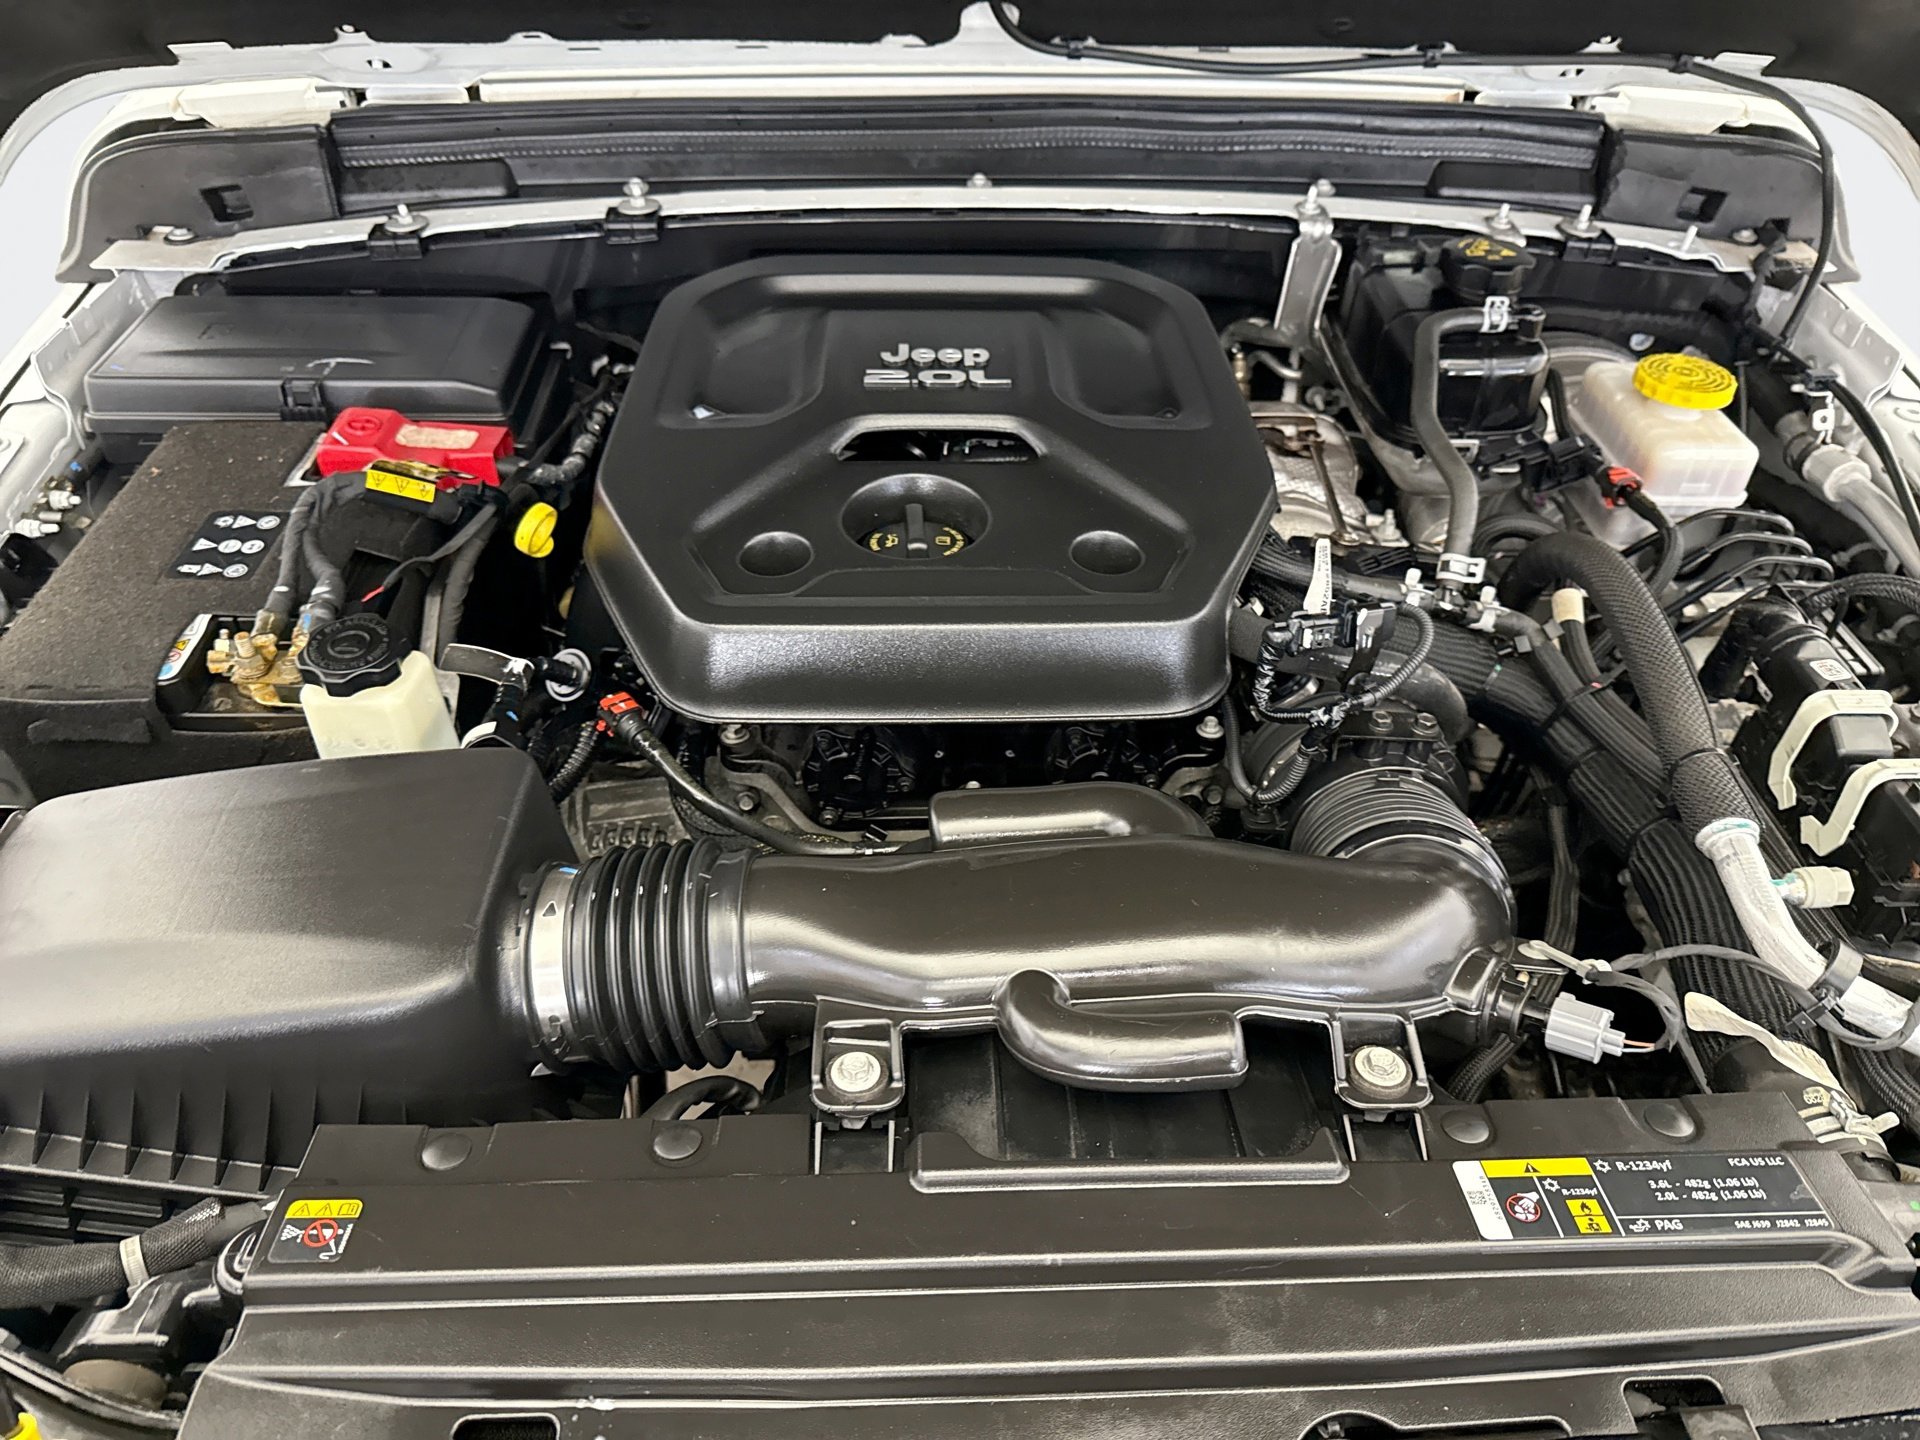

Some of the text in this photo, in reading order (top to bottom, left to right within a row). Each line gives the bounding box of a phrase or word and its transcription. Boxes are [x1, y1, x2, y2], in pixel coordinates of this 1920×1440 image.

[880, 343, 990, 367] Jeep
[863, 369, 1012, 387] 2.0L
[1615, 1160, 1672, 1172] R-1234yf
[1727, 1157, 1785, 1167] FCA US LLC
[1648, 1179, 1673, 1189] 3.6L
[1684, 1178, 1711, 1189] 482g
[1712, 1177, 1741, 1189] (1.06
[1740, 1176, 1760, 1188] Lb)
[1561, 1188, 1598, 1196] R-1234yf
[1655, 1191, 1680, 1201] 2.0L
[1691, 1190, 1719, 1201] 482g
[1720, 1189, 1749, 1201] (1.06
[1747, 1188, 1767, 1200] Lb)
[1655, 1219, 1684, 1231] PAG
[1734, 1220, 1752, 1229] SAE
